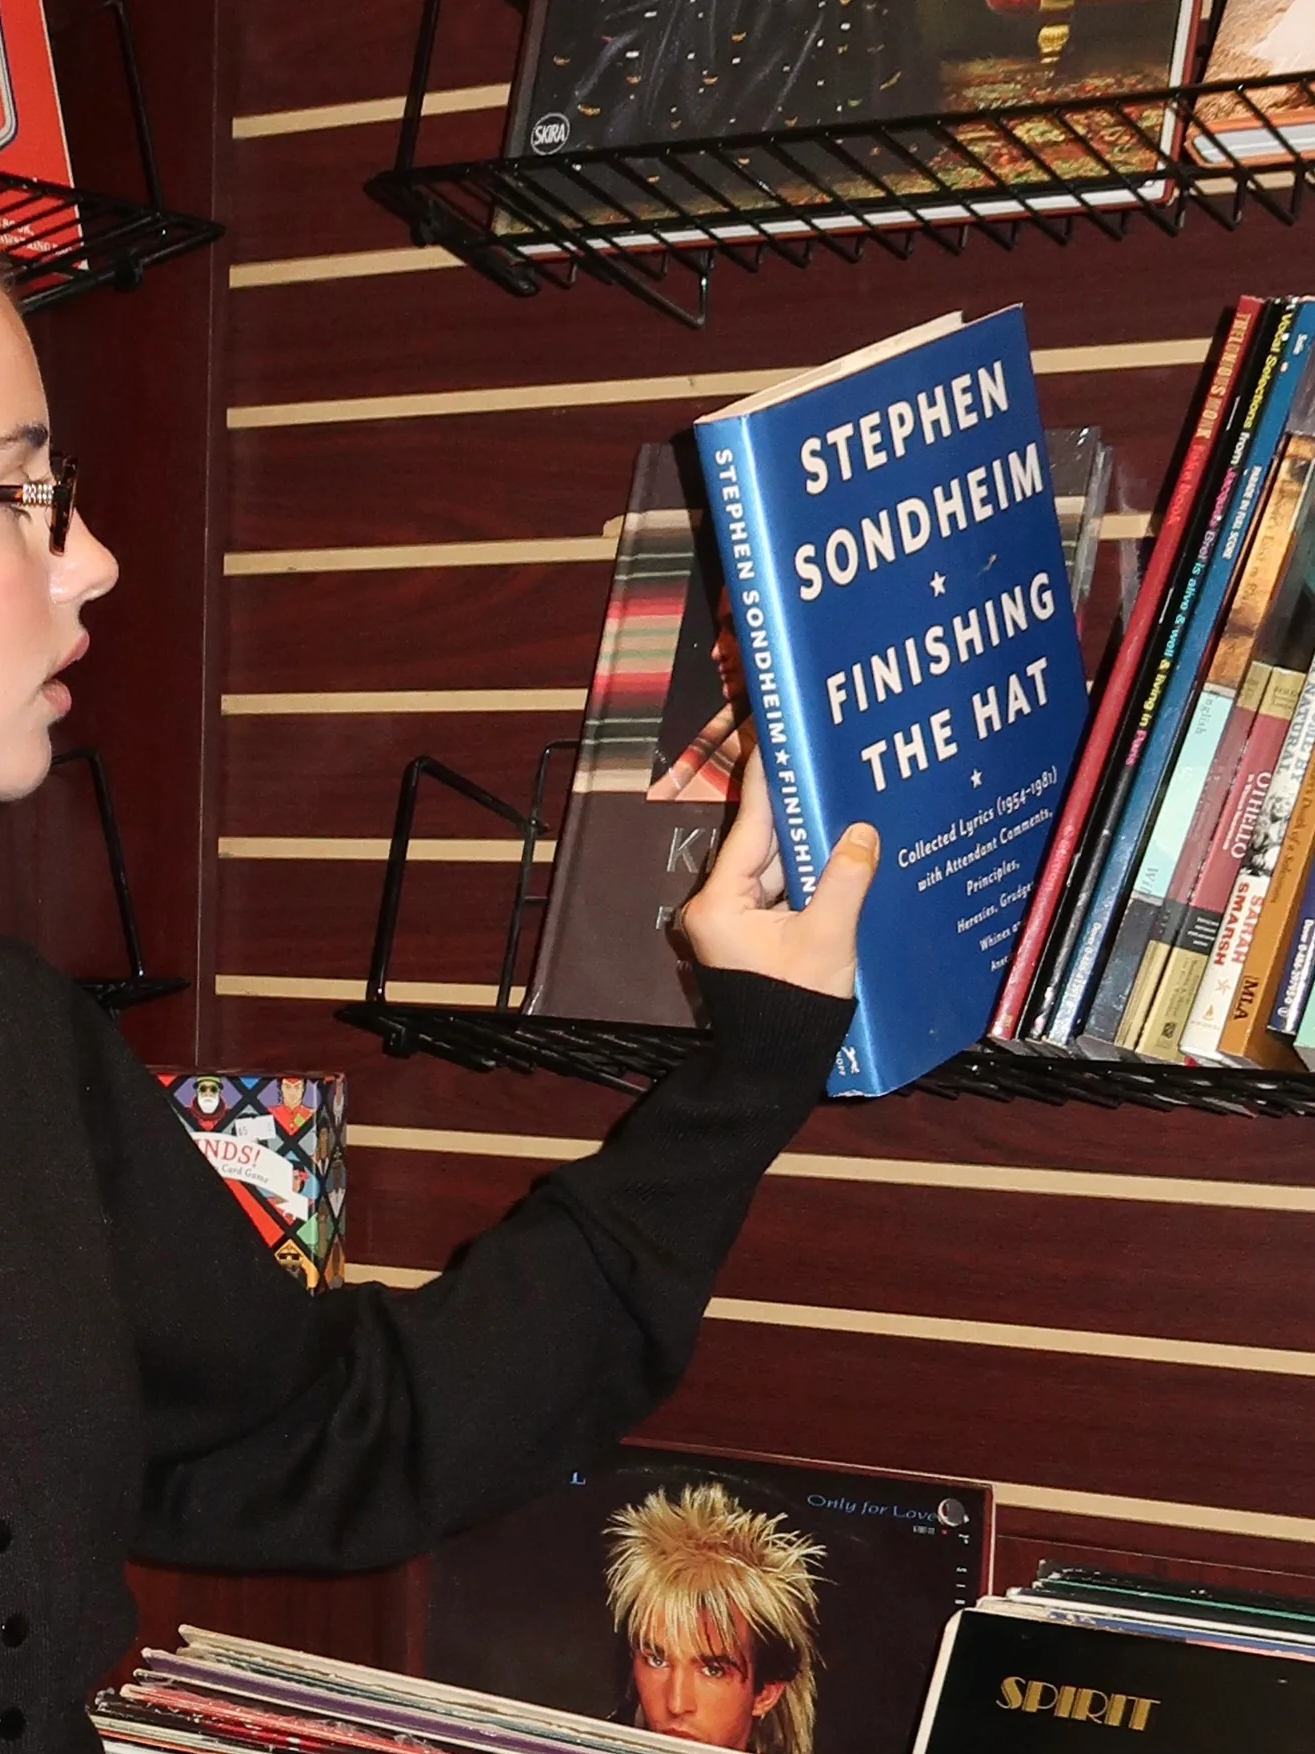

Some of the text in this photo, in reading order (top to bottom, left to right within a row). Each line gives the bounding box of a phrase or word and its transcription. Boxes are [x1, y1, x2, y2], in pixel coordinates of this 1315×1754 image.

[534, 123, 565, 146] SKIRA
[1270, 312, 1293, 353] Vocal
[1243, 354, 1278, 429] Selections
[800, 359, 1010, 496] STEPHEN
[1230, 433, 1251, 465] from
[794, 444, 1044, 602] SONDHEIM
[1199, 531, 1217, 562] Brel
[1221, 530, 1239, 560] SCORE
[1192, 562, 1203, 575] is
[712, 447, 757, 581] STEPHEN
[740, 589, 789, 745] SONDHEIM
[1180, 578, 1199, 613] alive
[1175, 614, 1186, 625] &
[825, 572, 1056, 725] FINISHING
[1164, 626, 1181, 658] well
[1160, 658, 1171, 669] &
[1143, 671, 1167, 710] living
[861, 656, 1049, 794] THE HAT
[1139, 711, 1151, 728] in
[1126, 729, 1147, 767] Paris
[1231, 771, 1271, 859] OTHELLO
[897, 823, 957, 868] Collected
[959, 806, 995, 838] Lyrics
[917, 806, 1054, 892] with Attendant Comments,
[966, 859, 1021, 896] Principles,
[999, 880, 1034, 908] Grudge
[1213, 882, 1249, 966] SMARSH
[1230, 895, 1263, 964] SARAH
[1234, 976, 1259, 1021] MLA
[196, 1139, 262, 1168] NDS!
[221, 1162, 243, 1175] Card
[244, 1169, 270, 1185] Game
[806, 1494, 939, 1522] Only for Love
[995, 1676, 1162, 1731] SPIRIT
